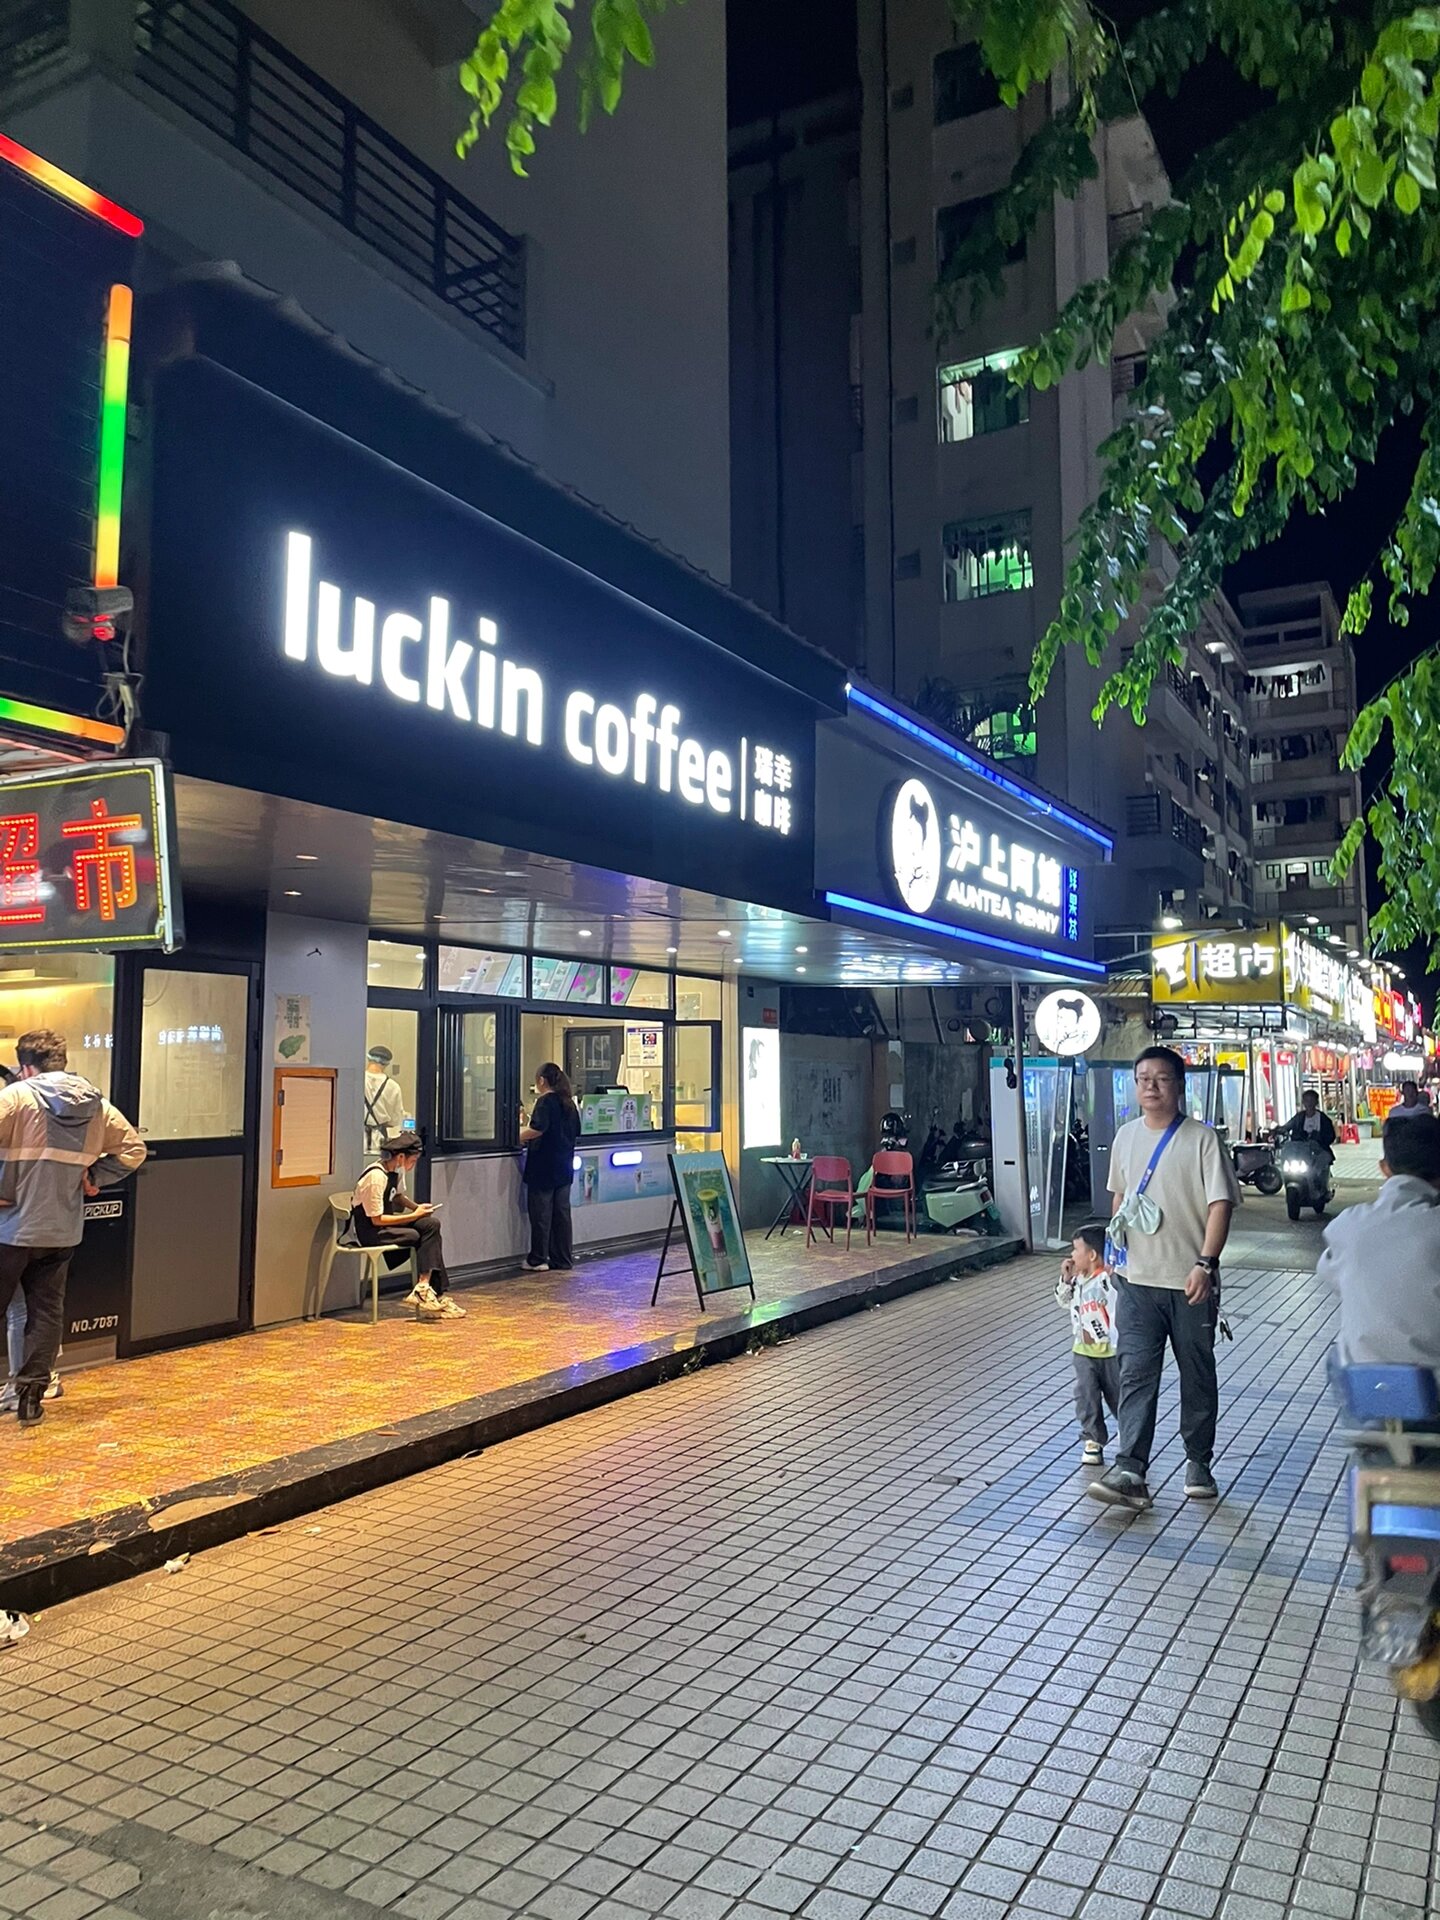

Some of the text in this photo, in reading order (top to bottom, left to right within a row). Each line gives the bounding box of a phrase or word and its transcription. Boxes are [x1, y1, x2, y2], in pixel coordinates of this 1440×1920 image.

[284, 531, 732, 813] luckin coffee
[946, 878, 1013, 921] AUNTEA
[1200, 942, 1276, 979] 超市
[84, 1203, 120, 1217] PICKUP
